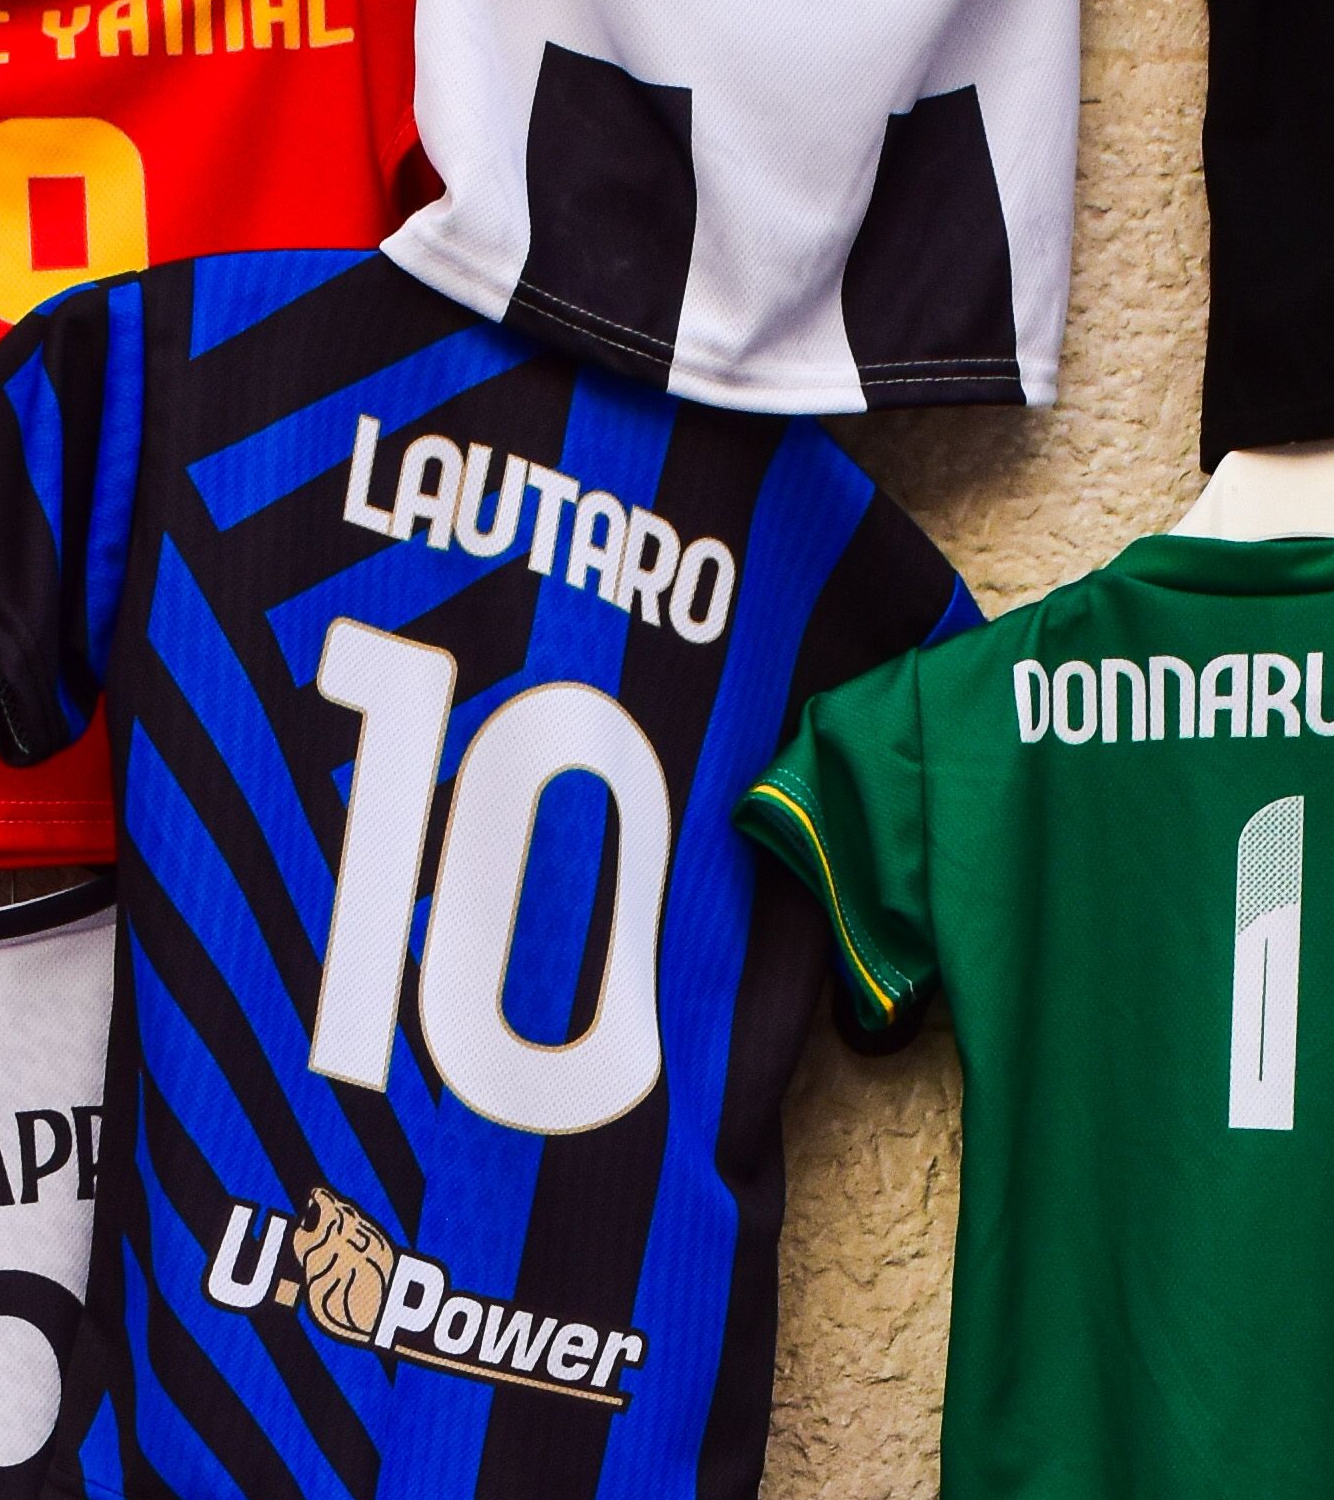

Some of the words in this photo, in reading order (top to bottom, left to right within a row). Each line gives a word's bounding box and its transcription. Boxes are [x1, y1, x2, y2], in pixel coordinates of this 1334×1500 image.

[343, 413, 736, 645] LAUTARO
[308, 616, 672, 1135] 10
[1228, 795, 1305, 1131] 1
[374, 1253, 644, 1389] Power
